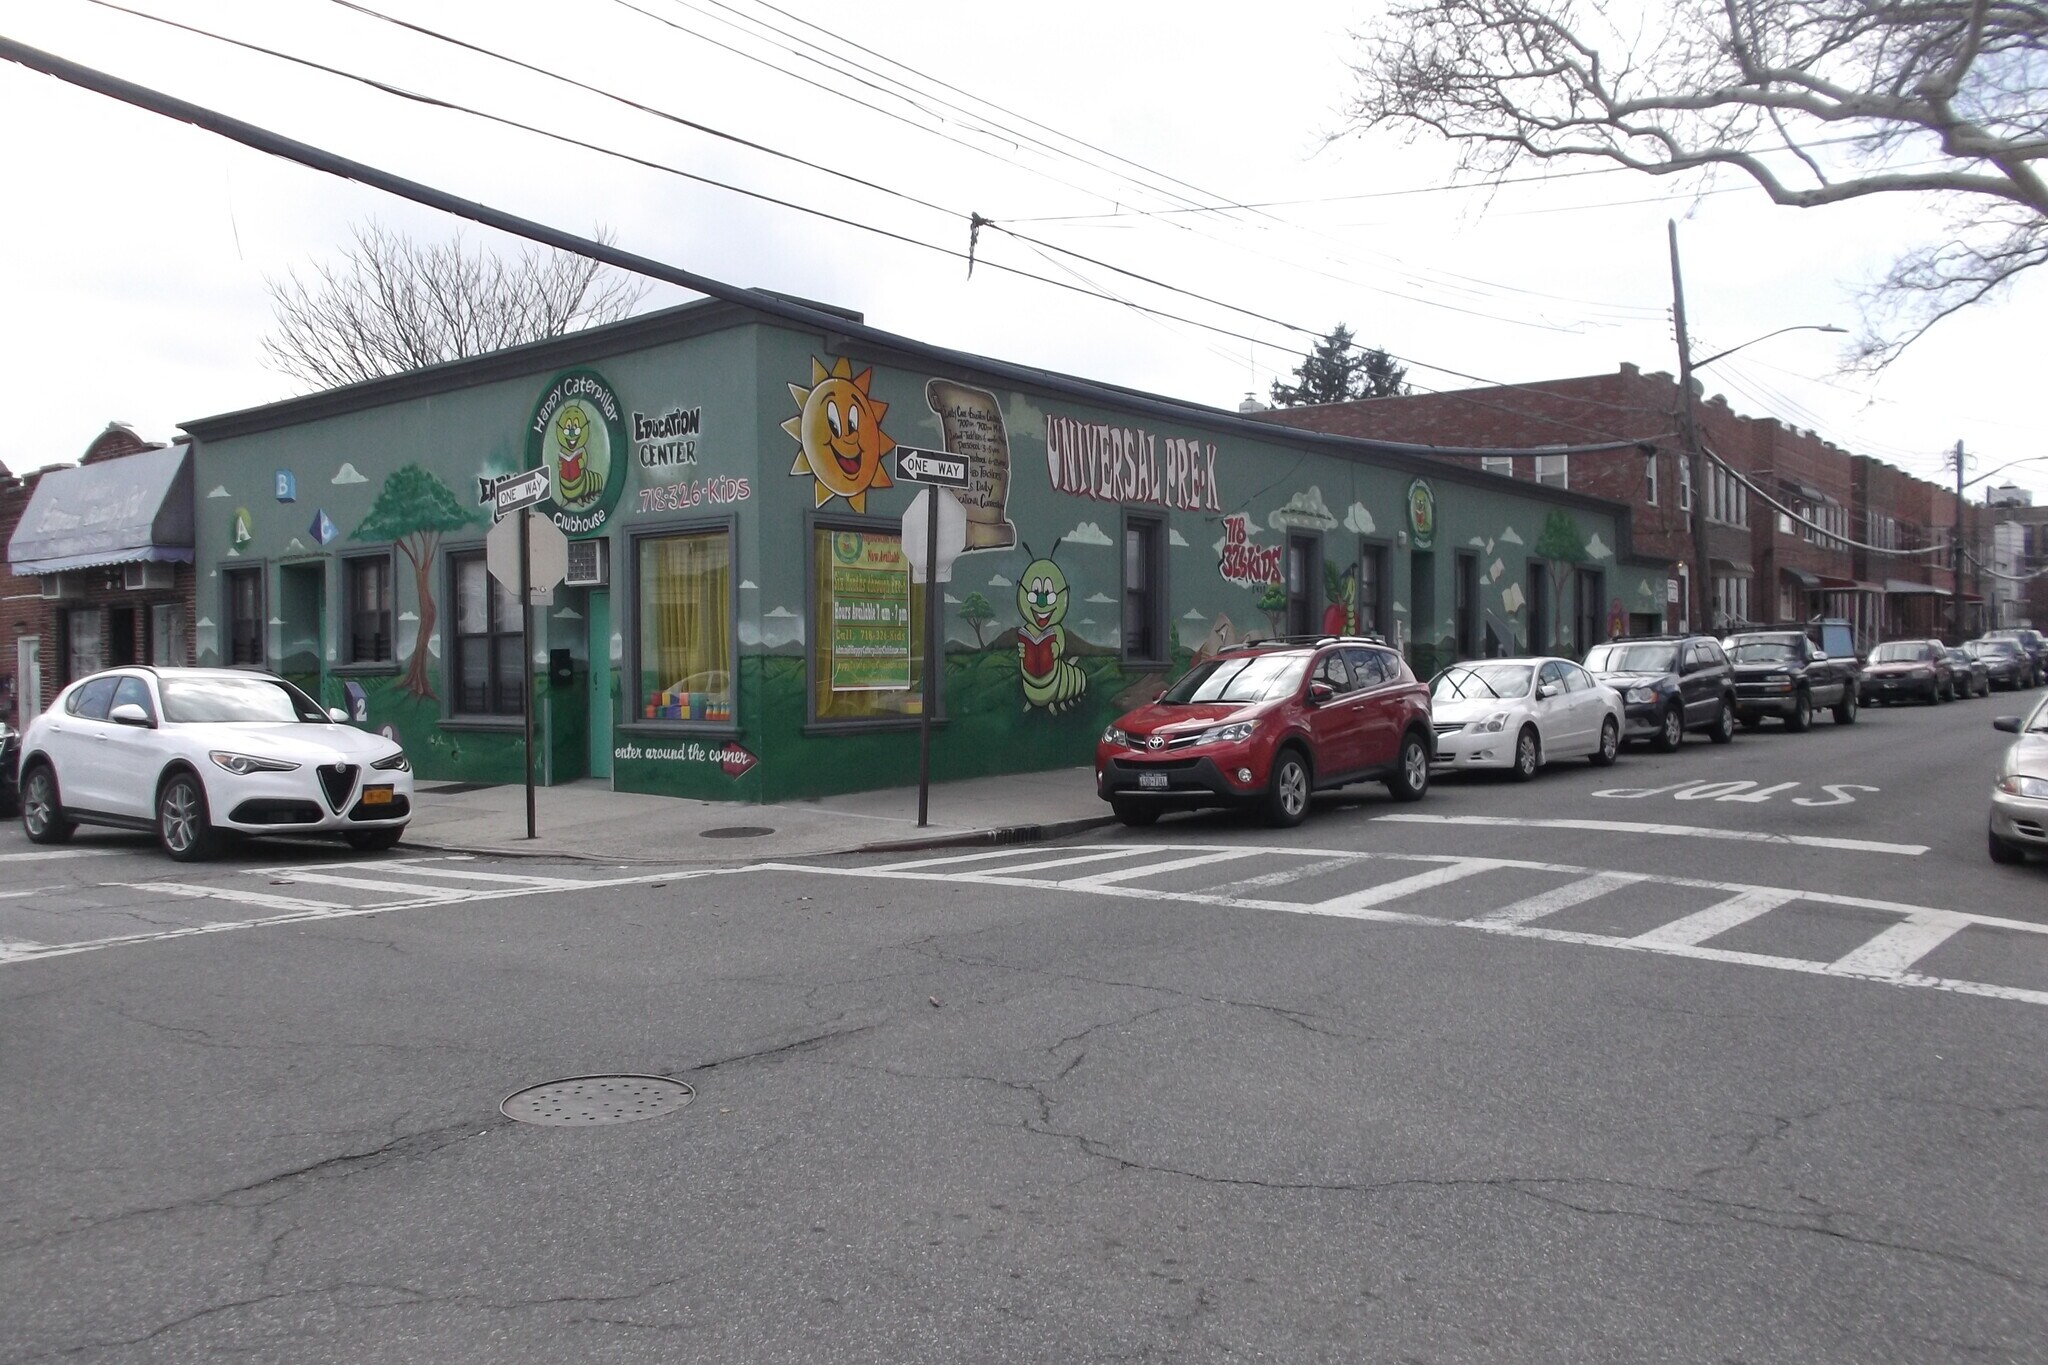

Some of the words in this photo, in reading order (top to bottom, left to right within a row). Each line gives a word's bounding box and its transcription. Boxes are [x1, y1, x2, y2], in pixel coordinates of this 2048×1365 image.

[533, 385, 563, 433] Happy
[564, 377, 618, 422] Caterpillar
[640, 441, 697, 468] CENTER
[1046, 414, 1161, 504] UNIVERSAL
[908, 458, 928, 472] ONE
[938, 462, 960, 477] WAY
[278, 473, 288, 495] B
[501, 489, 516, 504] ONE
[525, 479, 542, 496] WAY
[236, 516, 252, 543] A
[553, 509, 606, 532] Clubhouse
[1224, 516, 1248, 544] 718
[834, 602, 851, 620] Hours
[852, 602, 876, 620] Available
[356, 698, 367, 721] 2
[615, 743, 642, 759] enter
[645, 743, 685, 760] around
[688, 743, 706, 762] the
[709, 749, 751, 765] corner
[1591, 780, 1881, 806] STOP
